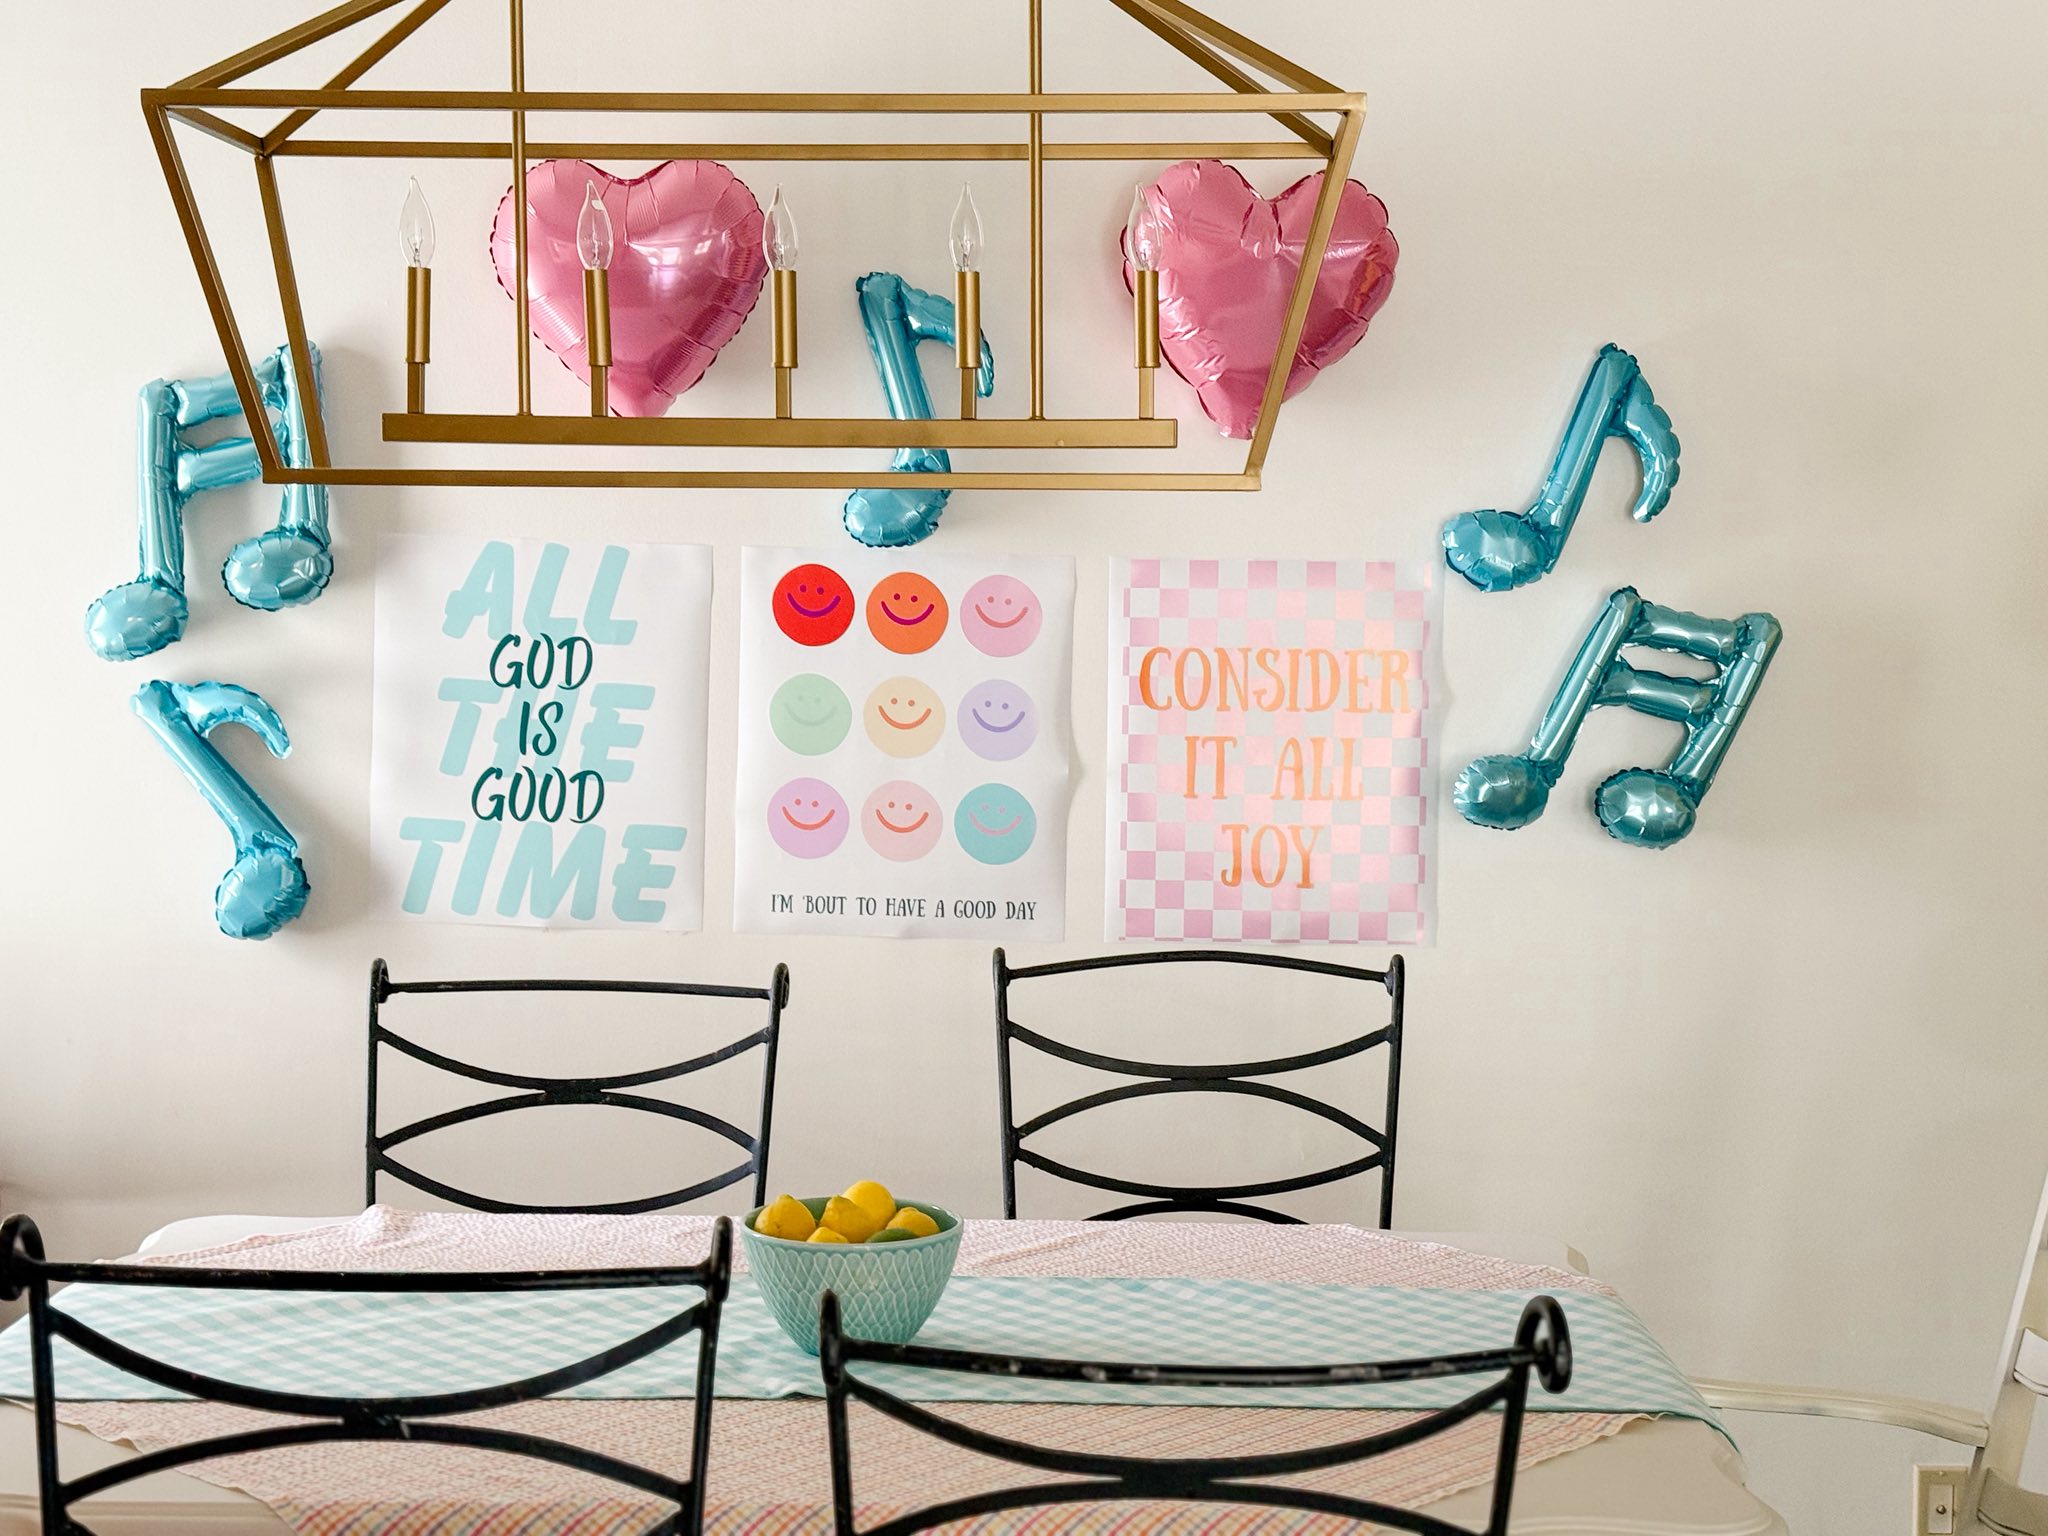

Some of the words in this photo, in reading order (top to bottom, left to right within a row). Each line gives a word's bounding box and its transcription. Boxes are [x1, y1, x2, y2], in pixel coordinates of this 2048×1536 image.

[441, 540, 638, 645] ALL
[489, 633, 593, 690] GOD
[1139, 646, 1411, 713] CONSIDER
[438, 677, 655, 783] THE
[519, 701, 563, 756] IS
[471, 766, 605, 823] GOOD
[1183, 736, 1237, 800] IT
[1270, 737, 1363, 800] ALL
[399, 816, 687, 922] TIME
[1221, 824, 1323, 889] JOY
[771, 894, 794, 914] I'M
[803, 895, 847, 915] 'BOUT
[856, 897, 877, 916] TO
[885, 898, 926, 917] HAVE
[935, 899, 945, 918] A
[953, 900, 996, 919] GOOD
[1006, 901, 1037, 920] DAY
